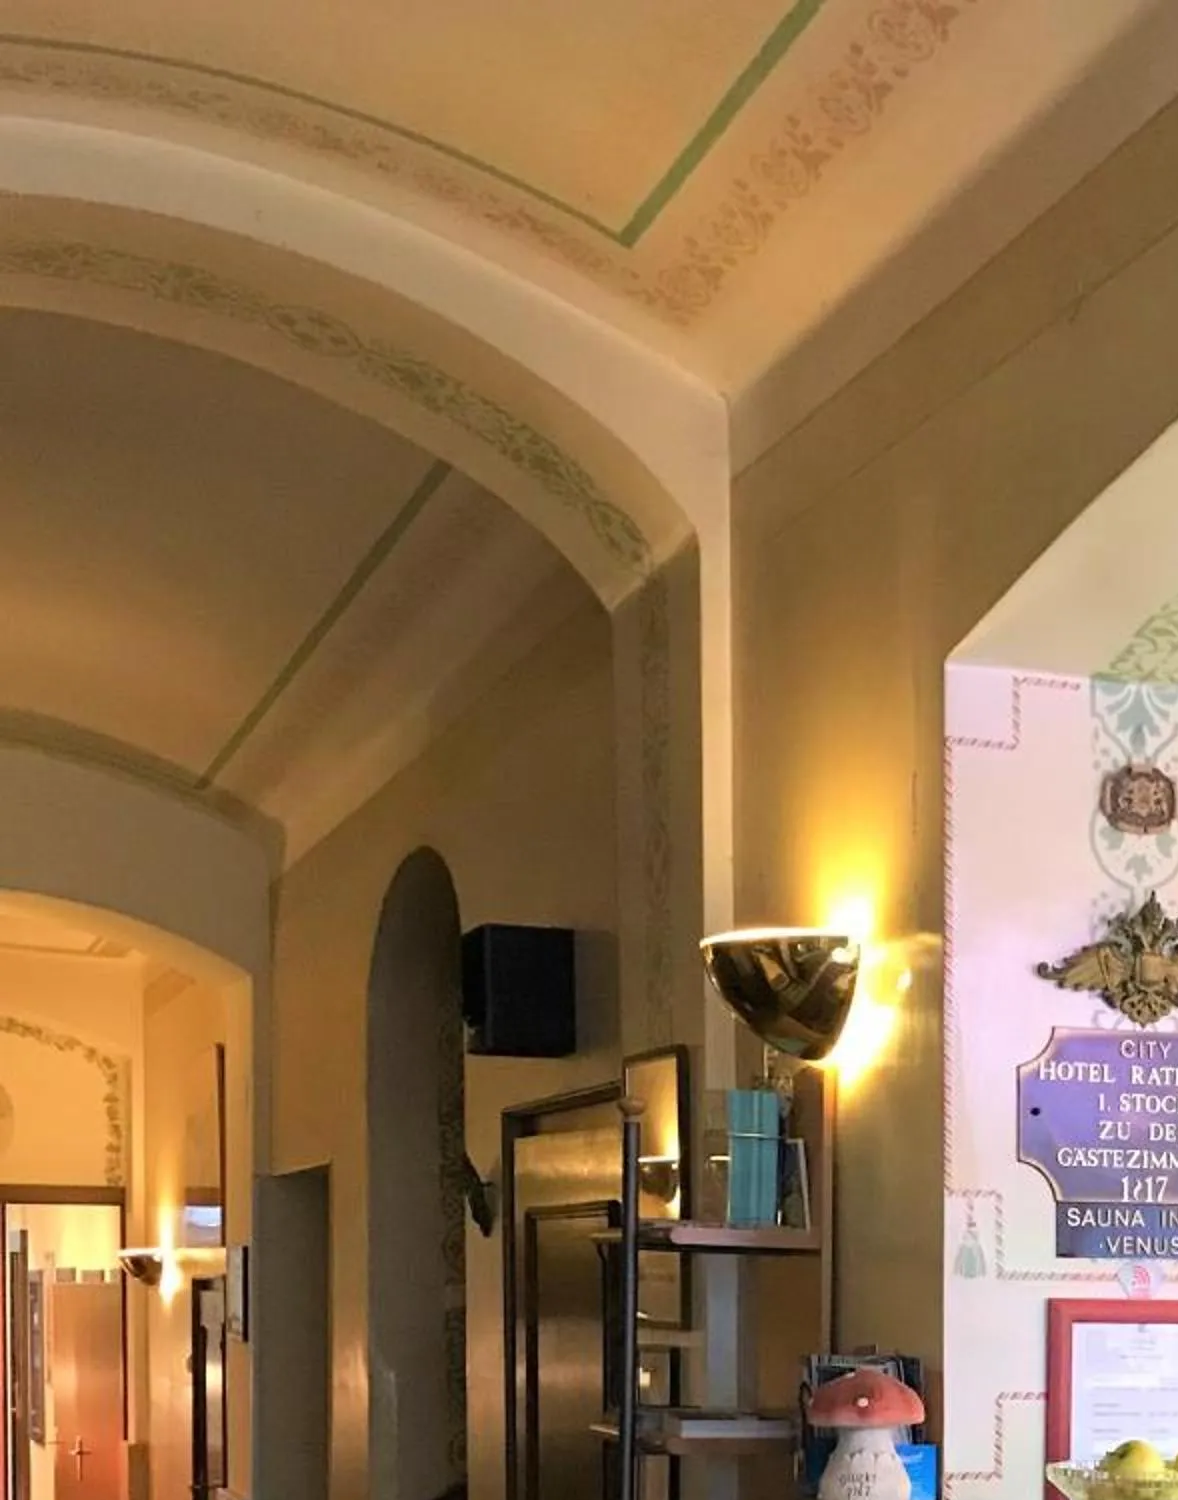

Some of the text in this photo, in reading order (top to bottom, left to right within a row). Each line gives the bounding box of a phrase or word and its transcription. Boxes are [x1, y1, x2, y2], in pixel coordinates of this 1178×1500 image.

[1120, 1039, 1172, 1059] CITY
[1039, 1061, 1116, 1084] HOTEL
[1099, 1120, 1132, 1141] ZU
[1067, 1207, 1145, 1228] SAUNA
